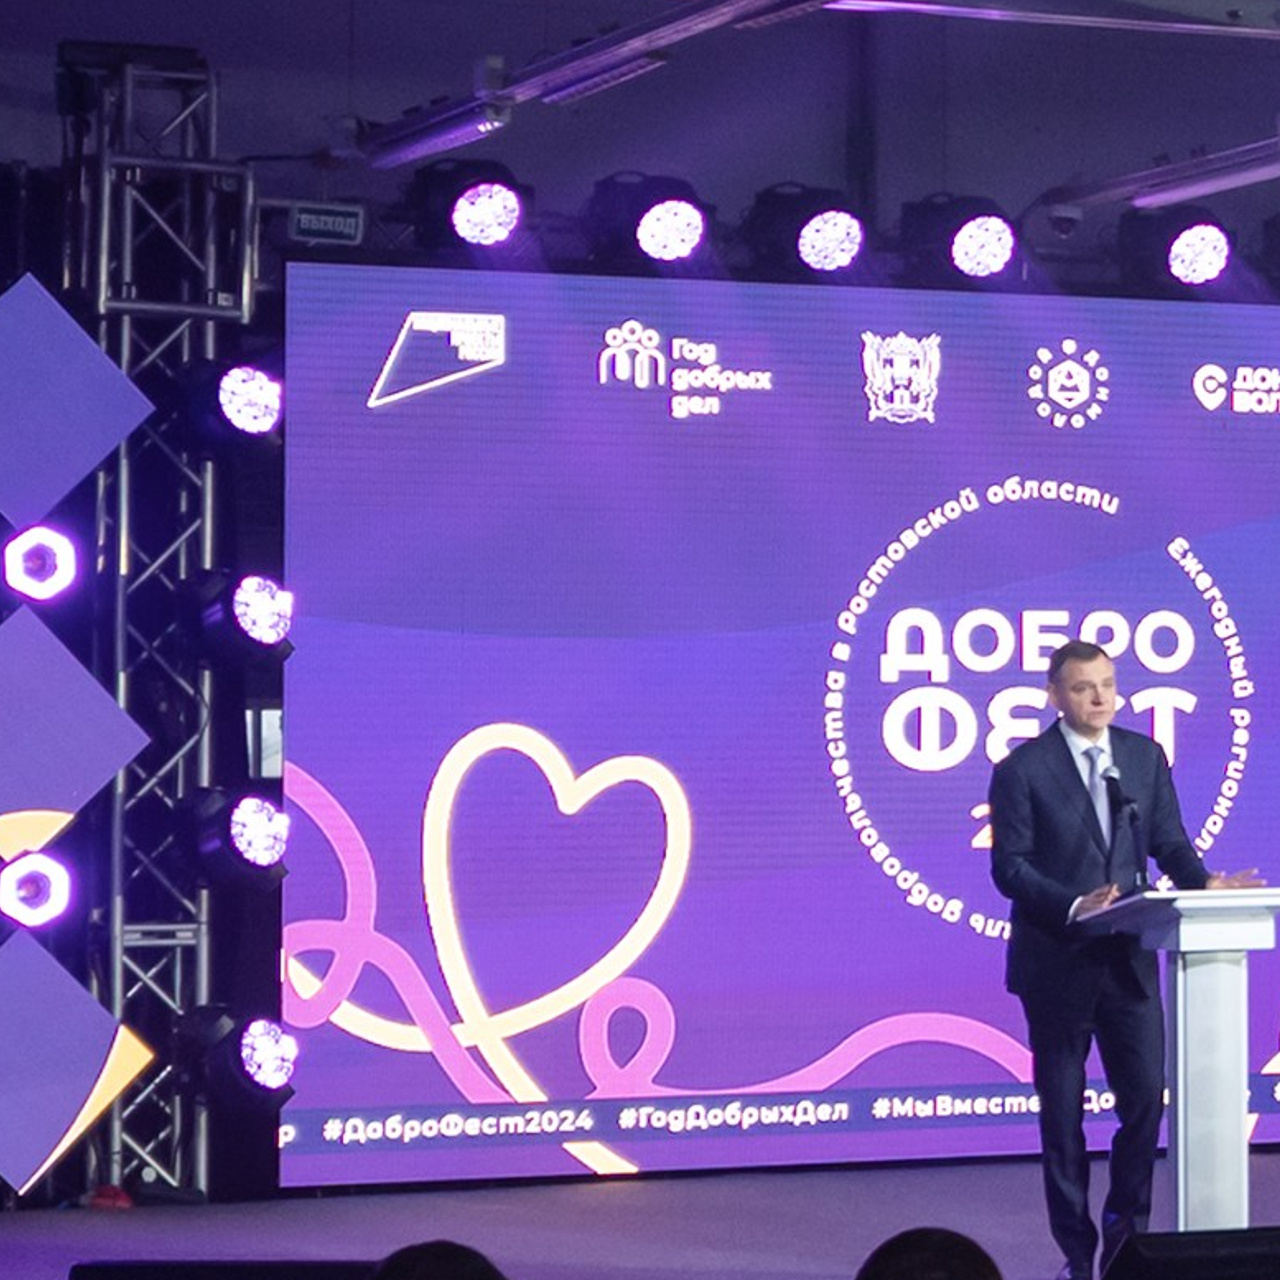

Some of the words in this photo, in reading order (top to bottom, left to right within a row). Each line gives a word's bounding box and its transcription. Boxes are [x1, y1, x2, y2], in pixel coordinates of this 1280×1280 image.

[300, 213, 356, 236] ВЫХОД
[672, 338, 716, 365] Год
[672, 365, 772, 392] добрых
[672, 396, 720, 418] дел
[986, 476, 1120, 514] области
[837, 487, 980, 635] Ростовской
[1167, 536, 1255, 699] Ежегодный
[831, 642, 851, 661] в
[880, 608, 1196, 682] ДОБРО
[882, 686, 1198, 770] ФЕТ
[824, 670, 964, 923] добровольчества
[323, 1110, 594, 1144] #ДоброФест2024
[618, 1100, 849, 1132] #ГодДобрыхДел
[872, 1095, 1040, 1119] #МыВместе
